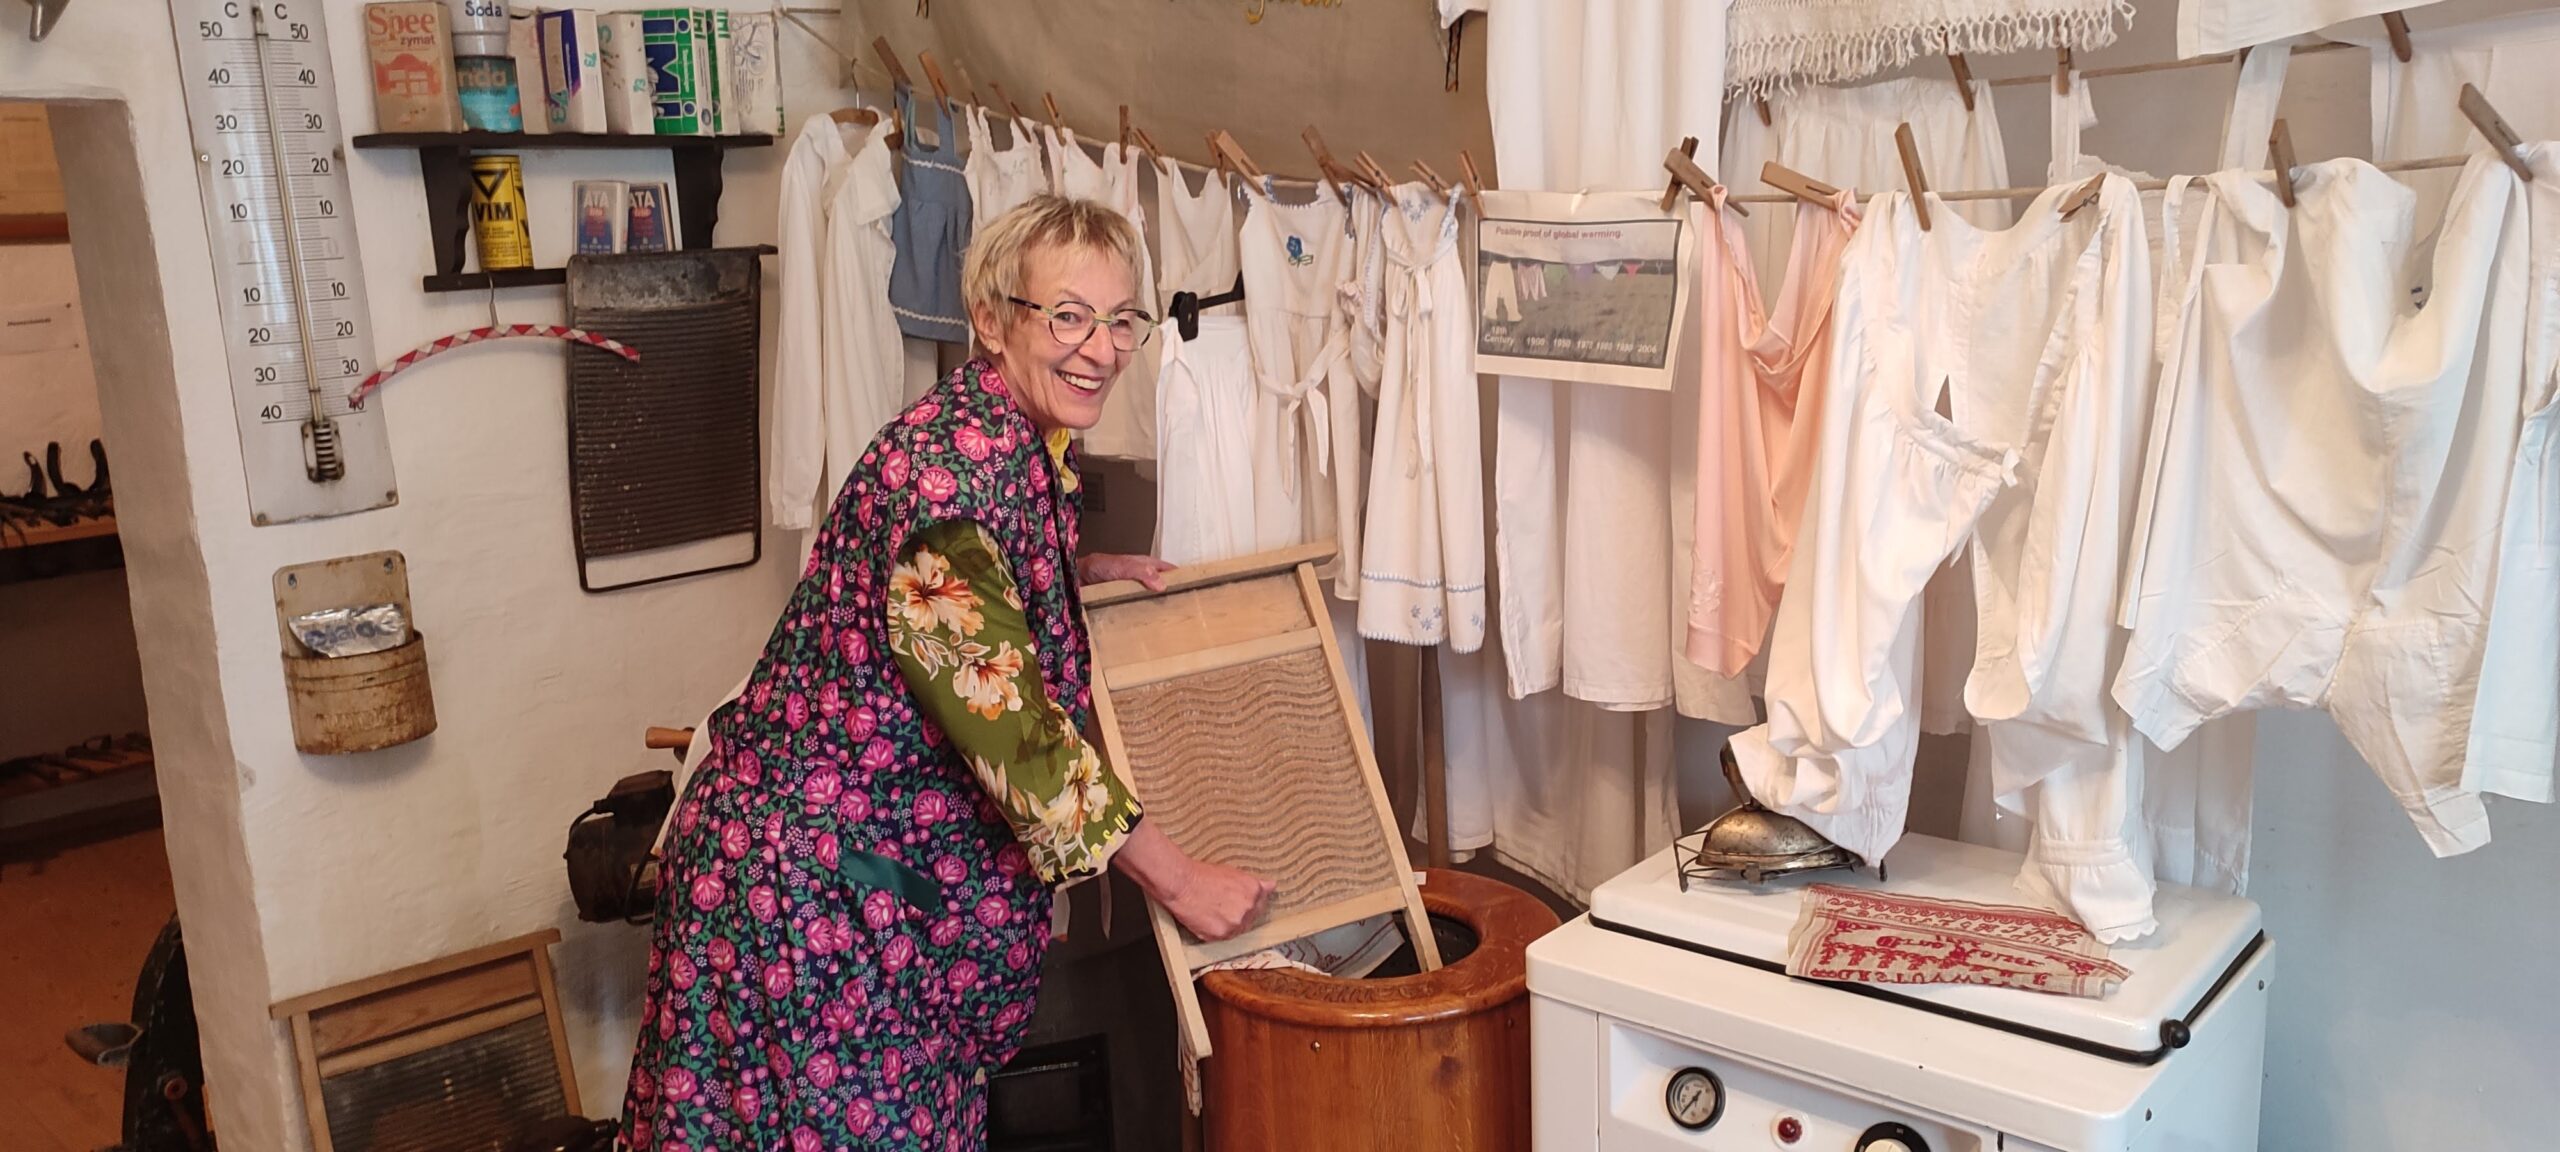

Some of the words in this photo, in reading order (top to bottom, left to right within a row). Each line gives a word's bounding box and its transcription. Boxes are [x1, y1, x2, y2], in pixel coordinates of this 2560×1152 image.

[224, 2, 239, 18] C
[274, 3, 288, 20] C
[465, 0, 503, 17] Soda
[200, 21, 223, 38] 50
[290, 23, 309, 40] 50
[368, 6, 435, 41] Spee
[208, 68, 231, 85] 40
[298, 69, 316, 85] 40
[214, 114, 238, 131] 30
[304, 114, 323, 130] 30
[222, 159, 245, 176] 20
[311, 157, 329, 173] 20
[583, 190, 609, 208] ATA
[230, 203, 248, 220] 10
[319, 199, 334, 215] 10
[473, 202, 513, 221] VIM
[1522, 229, 1542, 238] proof
[1543, 229, 1552, 237] of
[1553, 230, 1580, 239] global
[243, 287, 261, 303] 10
[331, 281, 346, 297] 10
[248, 327, 271, 343] 20
[335, 321, 354, 336] 20
[1484, 334, 1514, 346] Century
[254, 366, 276, 383] 30
[342, 358, 359, 375] 30
[260, 404, 282, 420] 40
